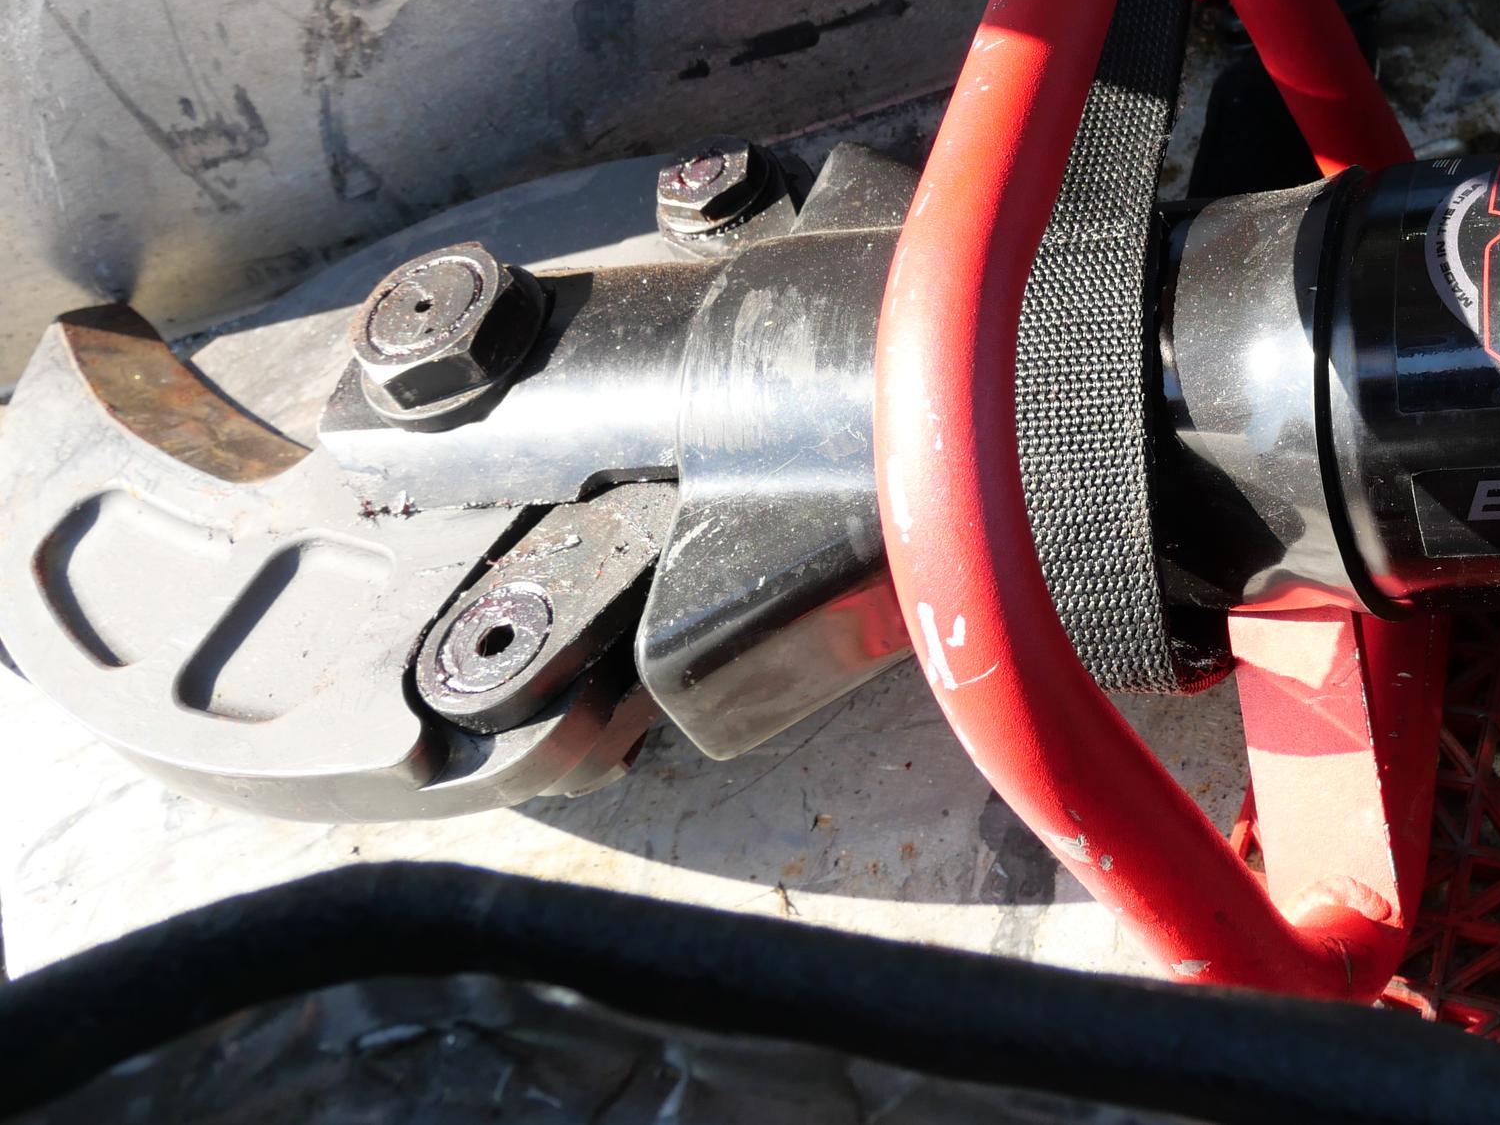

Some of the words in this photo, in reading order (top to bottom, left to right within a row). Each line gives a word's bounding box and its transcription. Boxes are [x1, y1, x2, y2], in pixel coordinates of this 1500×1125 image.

[1454, 181, 1485, 208] USA
[1436, 207, 1453, 238] THE
[1436, 239, 1447, 260] IN
[1446, 265, 1473, 309] MADE
